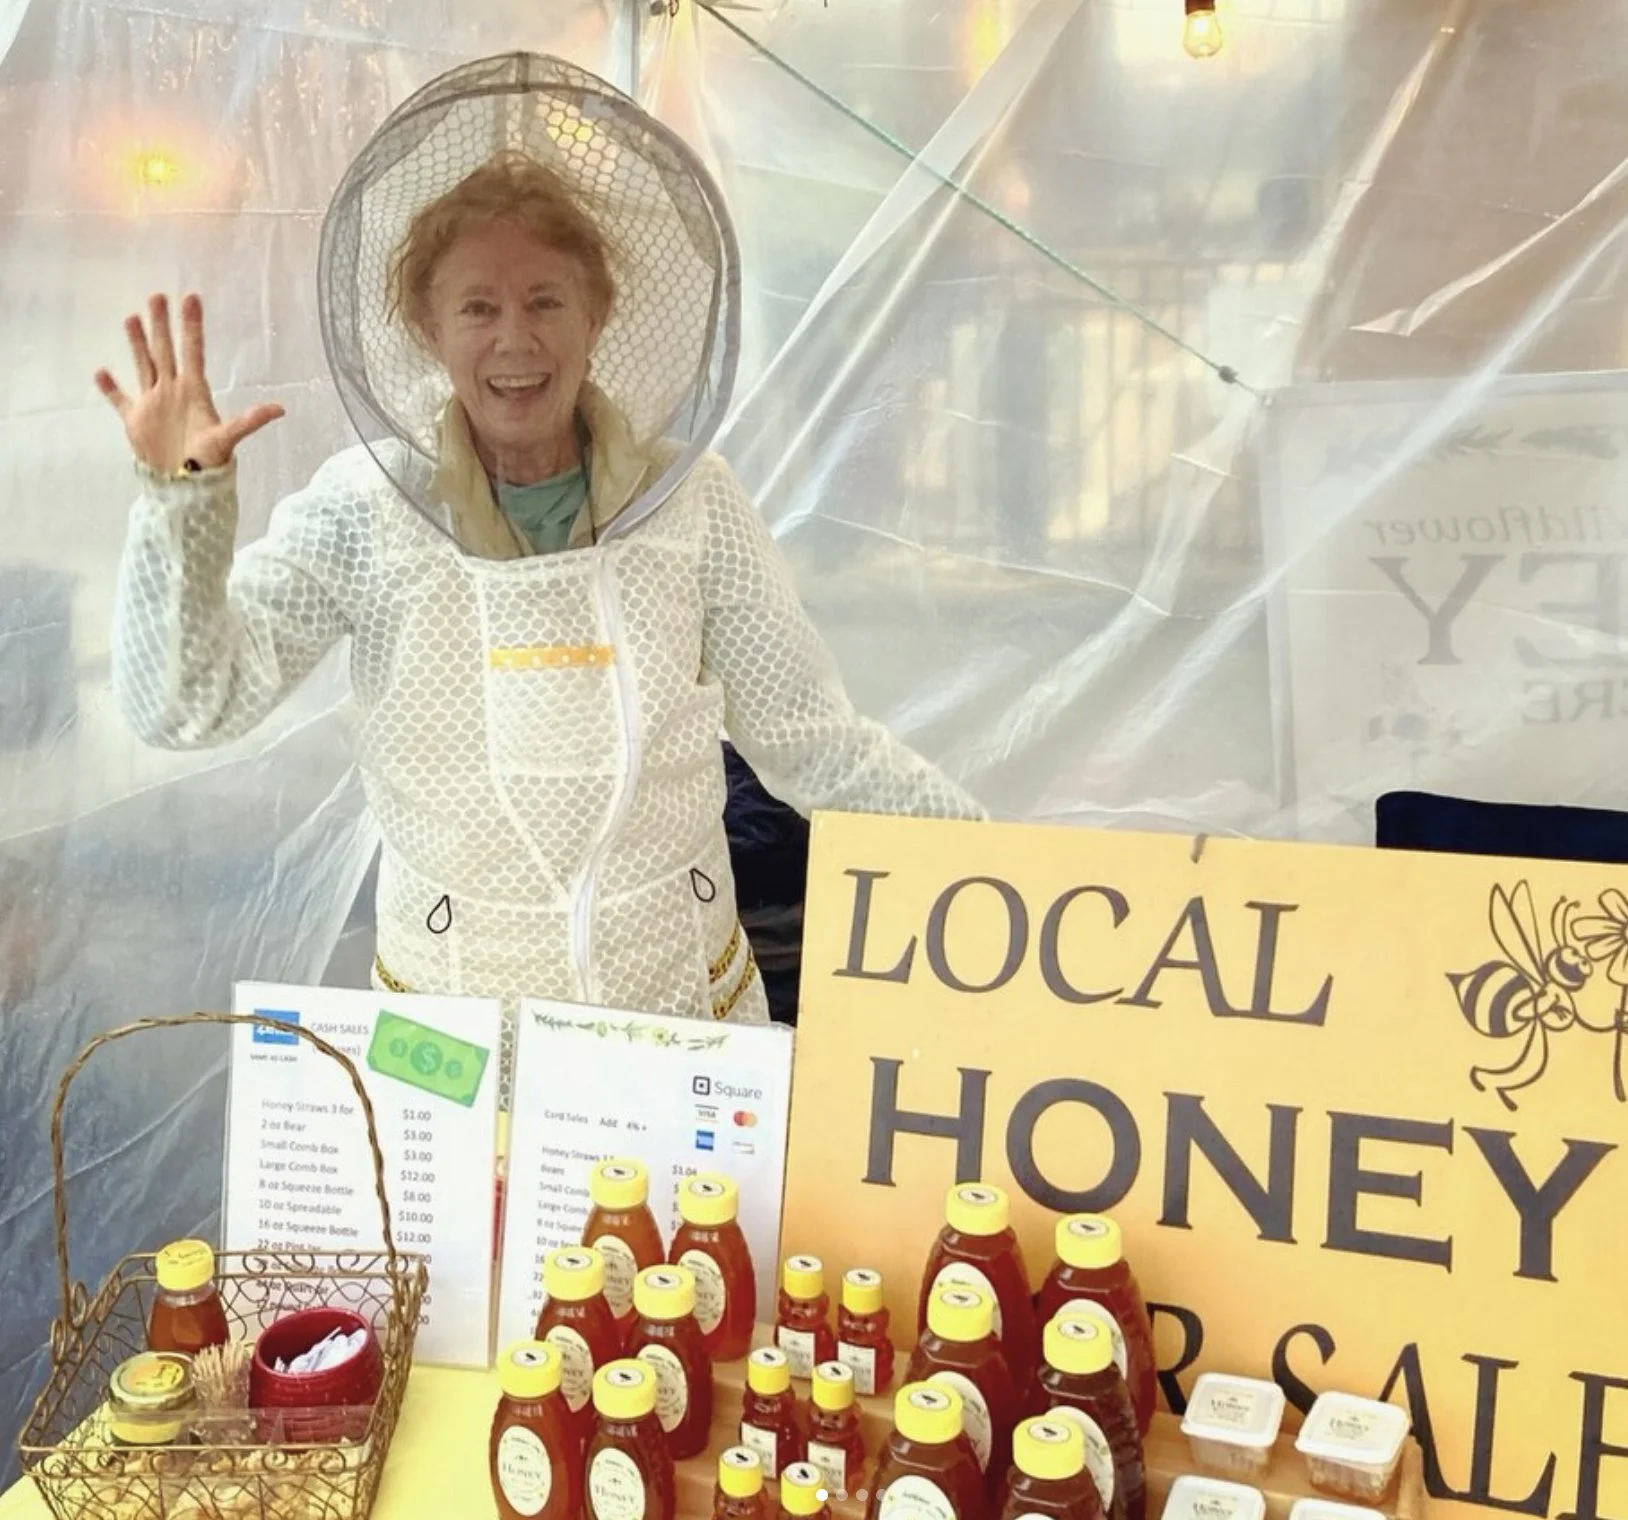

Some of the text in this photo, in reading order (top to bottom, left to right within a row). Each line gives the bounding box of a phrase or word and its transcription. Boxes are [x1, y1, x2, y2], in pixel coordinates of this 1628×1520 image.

[833, 868, 1333, 1027] LOCAL
[713, 1080, 763, 1101] Square
[261, 1099, 354, 1115] Honey Straws 3 for
[403, 1109, 432, 1121] $1.00
[261, 1119, 306, 1133] 2 oz Bear
[600, 1117, 618, 1128] Add
[403, 1129, 432, 1142] $3.00
[260, 1139, 339, 1155] Small Comb Box
[403, 1149, 432, 1162] $3.00
[258, 1160, 338, 1175] Large Comb Box
[861, 1056, 1618, 1282] HONEY
[400, 1170, 435, 1183] $12.00
[259, 1179, 355, 1197] 8 oz Squeeze Bottle
[403, 1191, 432, 1203] $8.00
[258, 1199, 342, 1216] 10 oz Spreadable
[398, 1210, 433, 1223] $10.00
[258, 1219, 359, 1237] 16 oz Squeeze Bottle
[396, 1231, 432, 1244] $12.00
